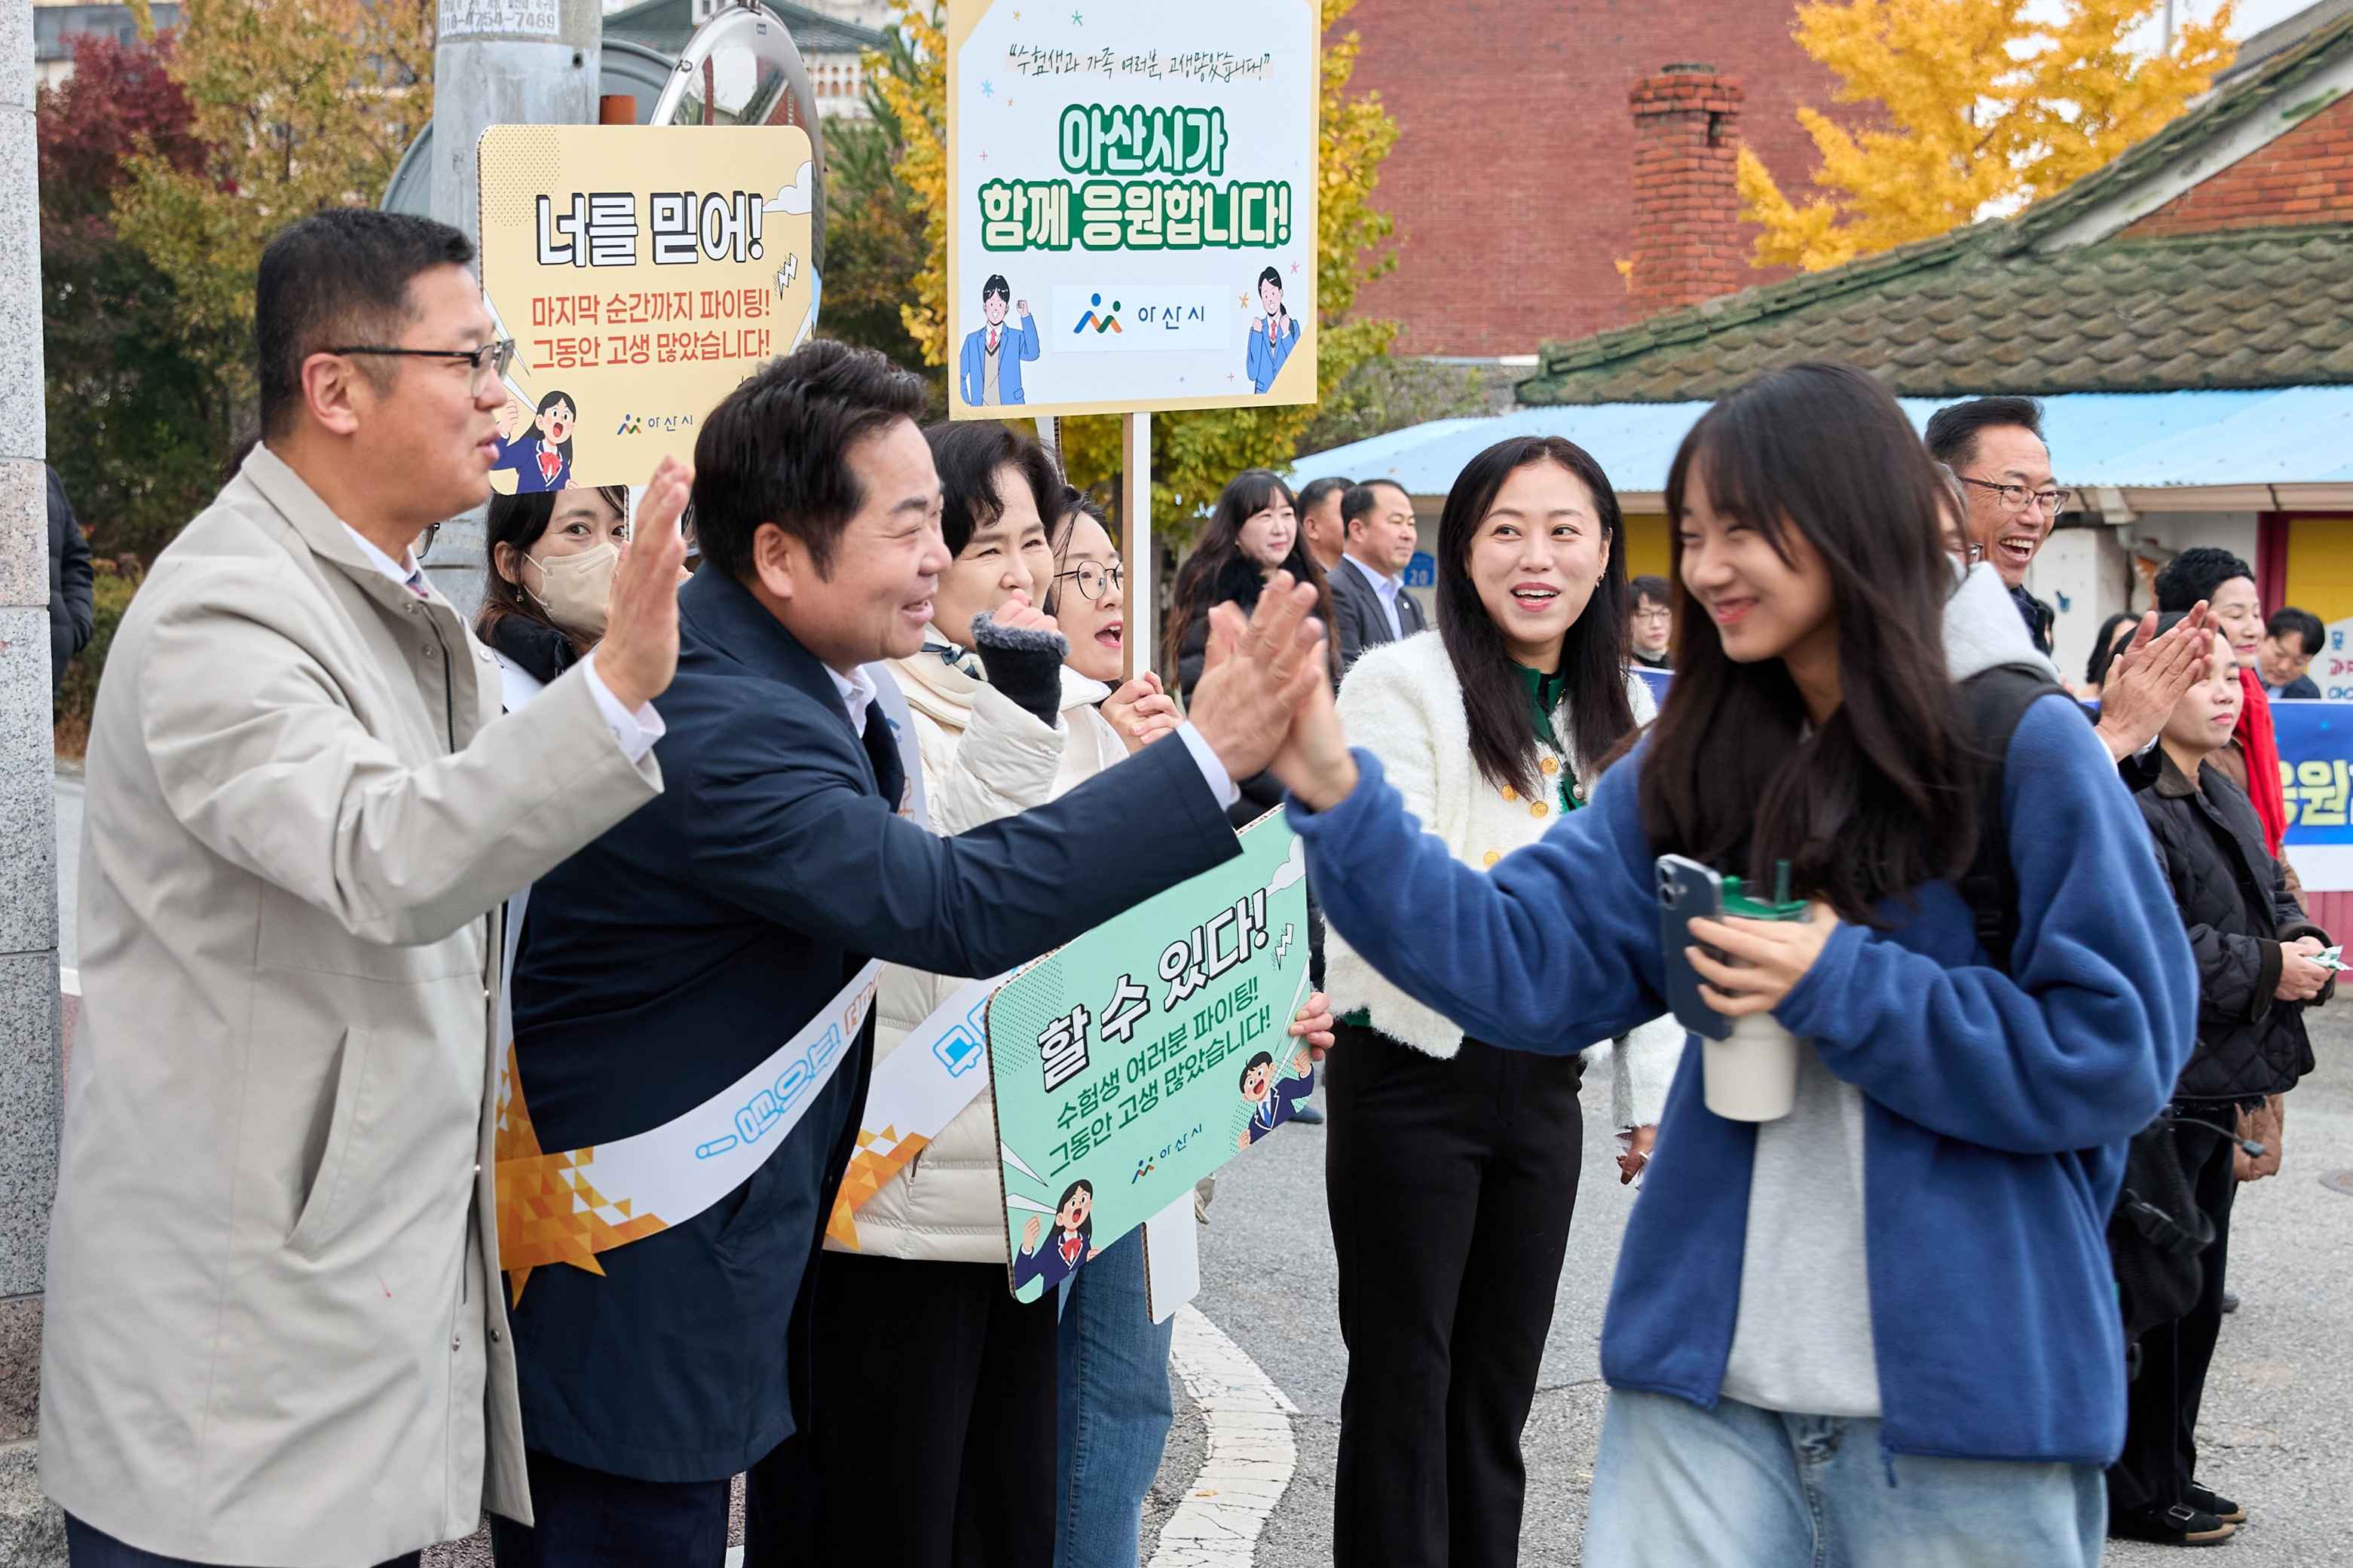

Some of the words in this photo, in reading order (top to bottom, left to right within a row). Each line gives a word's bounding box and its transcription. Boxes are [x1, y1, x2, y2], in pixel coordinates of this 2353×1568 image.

[1087, 47, 1115, 80] 가족
[1060, 104, 1228, 176] 아산시가
[536, 192, 638, 267] 너를
[650, 190, 763, 264] 믿어!
[980, 179, 1071, 251] 함께
[1080, 181, 1291, 251] 응원합니다!
[532, 295, 600, 327] 마지막
[605, 290, 692, 324] 순간까지
[699, 288, 770, 320] 파이팅!
[1137, 305, 1204, 329] 아산시
[532, 336, 601, 369] 그동안
[607, 334, 650, 365] 고생
[656, 329, 770, 363] 많았습니다!
[647, 414, 693, 432] 아산시
[1037, 1003, 1091, 1093] 할
[1100, 973, 1151, 1044] 수
[1158, 887, 1269, 1013] 있다!
[1057, 1067, 1120, 1130] 수험생
[1126, 1022, 1189, 1084] 여러분
[1193, 976, 1259, 1041] 파이팅!
[1049, 1111, 1113, 1177] 그동안
[1118, 1082, 1159, 1130] 고생
[1164, 1004, 1271, 1098] 많았습니다!
[1159, 1123, 1203, 1159] 아산시
